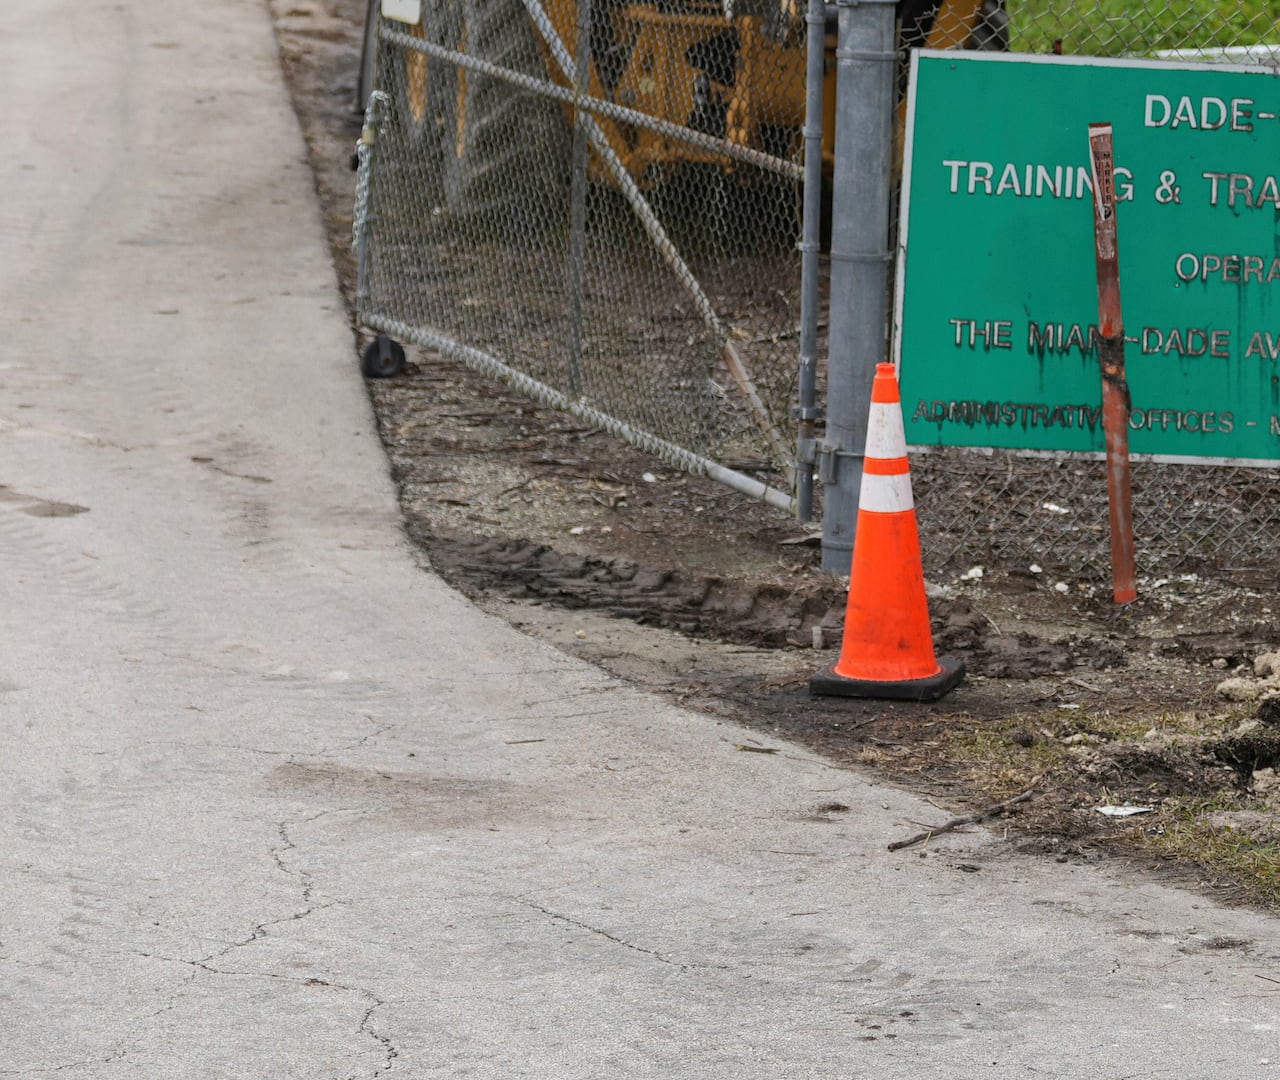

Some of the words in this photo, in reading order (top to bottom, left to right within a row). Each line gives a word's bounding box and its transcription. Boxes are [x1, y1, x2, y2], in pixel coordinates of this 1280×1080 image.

[942, 159, 1134, 202] TRAINING
[1154, 170, 1181, 205] &
[949, 319, 1012, 348] THE
[1027, 321, 1230, 358] MIA-DADE
[911, 399, 1108, 431] ADMINISTRATIV
[1127, 407, 1235, 434] OFFICES
